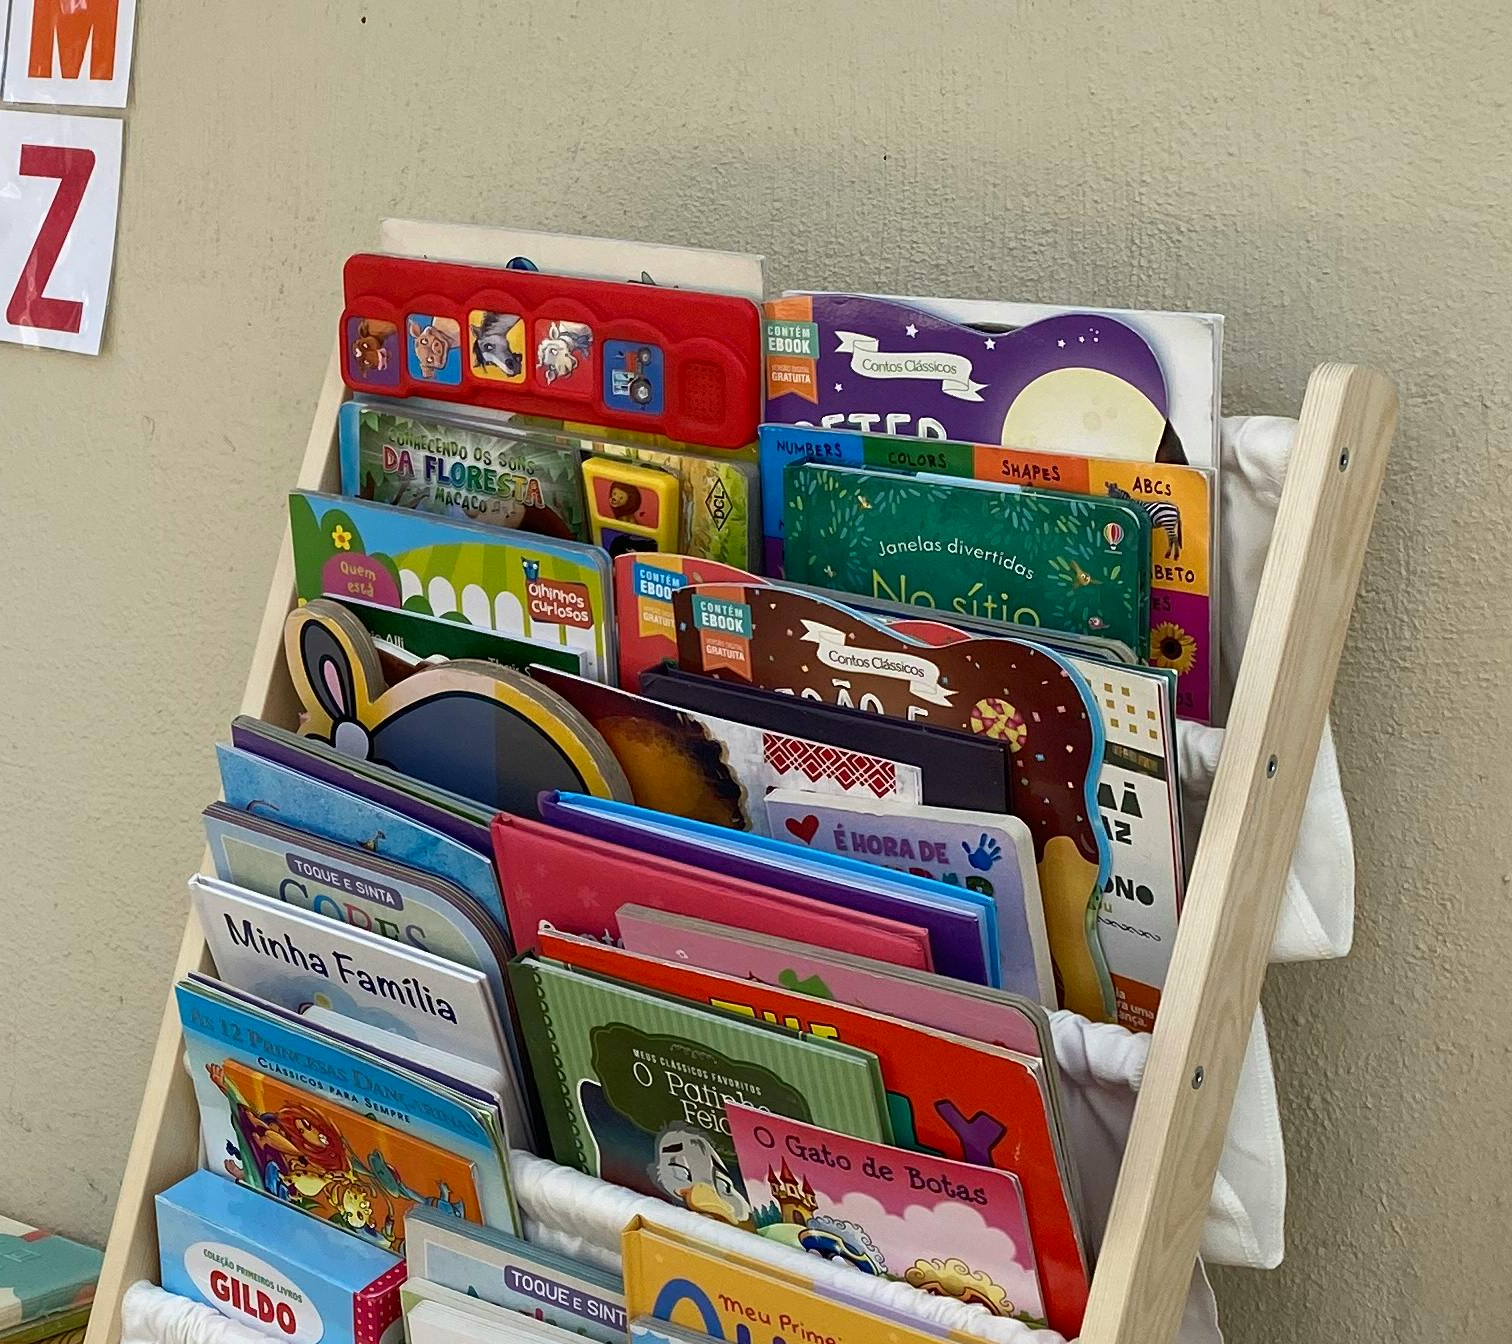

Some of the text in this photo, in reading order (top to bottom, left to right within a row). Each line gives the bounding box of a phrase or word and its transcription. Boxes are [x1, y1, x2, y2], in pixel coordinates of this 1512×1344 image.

[5, 143, 97, 334] Z
[767, 324, 810, 338] CONTÉM
[768, 337, 811, 354] EBOOK
[771, 372, 811, 384] GRATUITA
[862, 358, 957, 375] Contos Clássicos
[389, 427, 537, 475] CONHECENDO OS SONS
[777, 441, 842, 457] NUMBERS
[889, 451, 947, 469] COLORS
[382, 445, 545, 510] DA FLORESTA
[1002, 460, 1061, 482] SHAPES
[435, 486, 487, 513] MACACO
[712, 490, 726, 520] DCL
[340, 560, 377, 582] Quem
[878, 536, 1035, 580] Janelas divertidas
[347, 581, 375, 598] está
[640, 569, 680, 587] CONTÉM
[640, 580, 676, 600] EBOO
[528, 582, 585, 609] Olhinhos
[643, 612, 675, 629] GRATUIT
[700, 601, 743, 618] CONTÉM
[701, 612, 744, 633] EBOOK
[706, 644, 745, 661] GRATUITA
[829, 651, 925, 678] Contos Clássicos
[833, 823, 950, 865] É HORA DE
[294, 859, 395, 905] TOQUE E SINTA
[223, 913, 458, 1025] Minha Família
[220, 1016, 243, 1043] 12
[632, 1048, 762, 1096] MEUS CLÁSSICOS FAVORITOS
[633, 1061, 653, 1087] O
[753, 1125, 989, 1206] O Gato de Botas
[203, 1248, 303, 1304] COLEÇÃO PRIMEIROS LIVROS
[209, 1269, 297, 1335] GILDO
[511, 1270, 570, 1306] TOQUE
[573, 1298, 582, 1311] E
[587, 1300, 627, 1327] SINT
